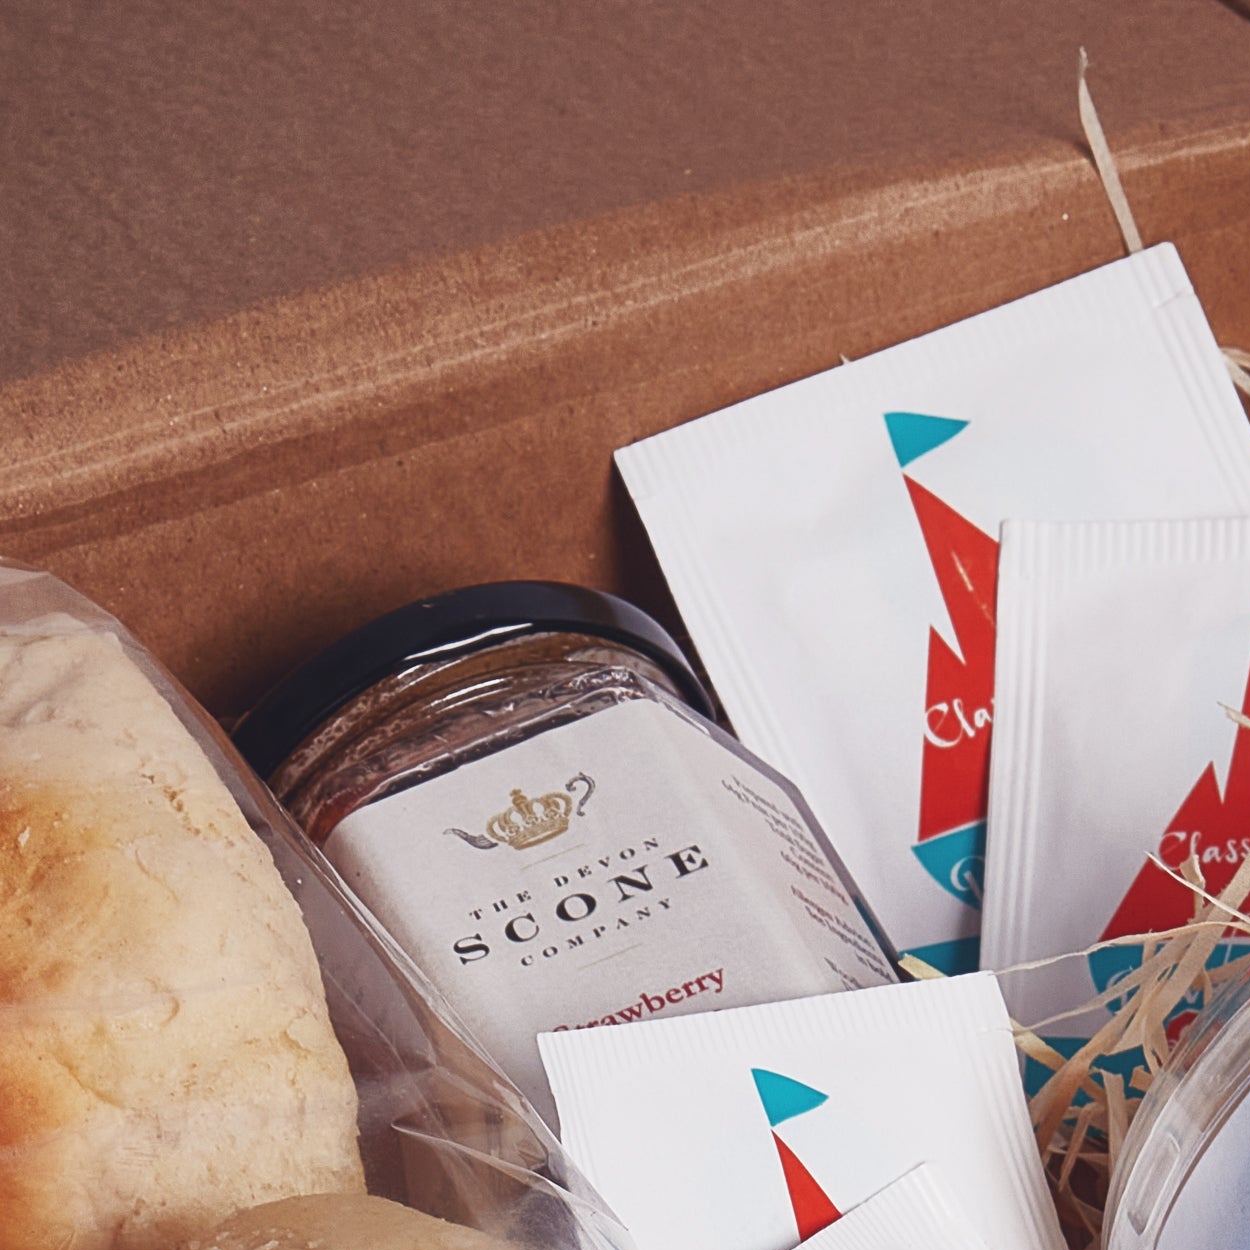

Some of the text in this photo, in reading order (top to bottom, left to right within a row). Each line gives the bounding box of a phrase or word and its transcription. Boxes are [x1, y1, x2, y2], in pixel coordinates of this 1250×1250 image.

[452, 844, 710, 966] SCONE
[469, 837, 659, 921] THE DEVON
[520, 897, 672, 967] COMPANY
[552, 967, 725, 1033] awberry
